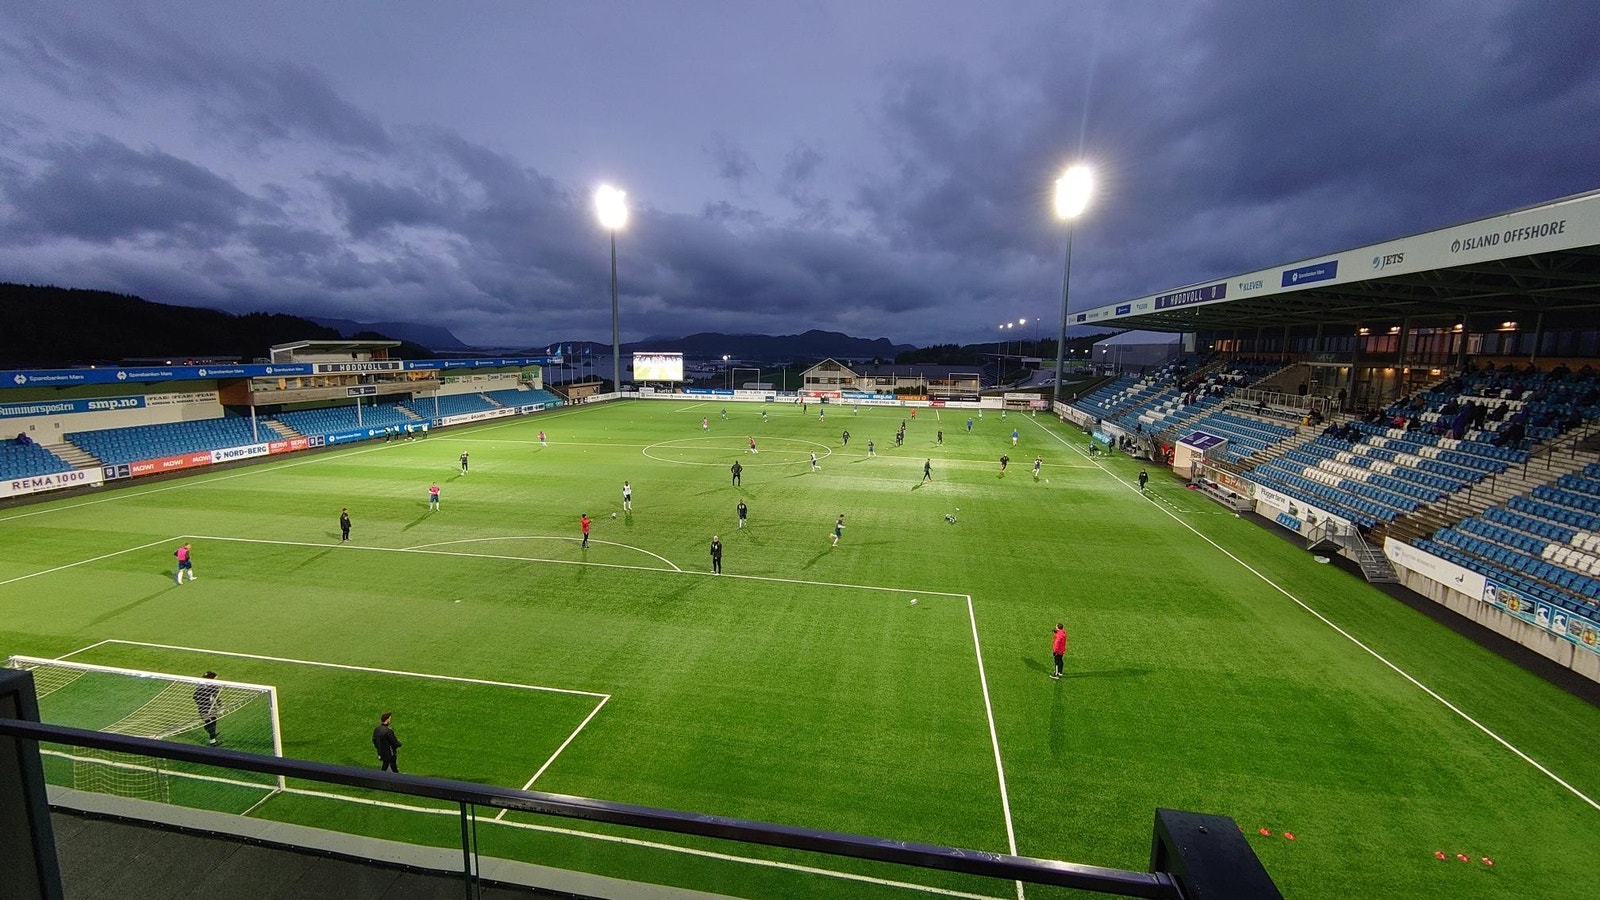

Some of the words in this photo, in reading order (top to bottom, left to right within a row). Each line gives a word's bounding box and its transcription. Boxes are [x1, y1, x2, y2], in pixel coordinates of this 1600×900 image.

[1462, 233, 1499, 251] ISLAND
[1503, 220, 1566, 244] OFFSHORE
[1380, 253, 1405, 270] JETS
[1243, 280, 1263, 292] KLEVEN
[88, 398, 137, 410] smp.no
[223, 445, 267, 458] NORD-BERG
[163, 459, 184, 467] MOWI
[192, 455, 211, 463] MOWI
[132, 463, 154, 472] MOWI
[12, 476, 53, 490] REMA
[56, 472, 85, 484] 1000
